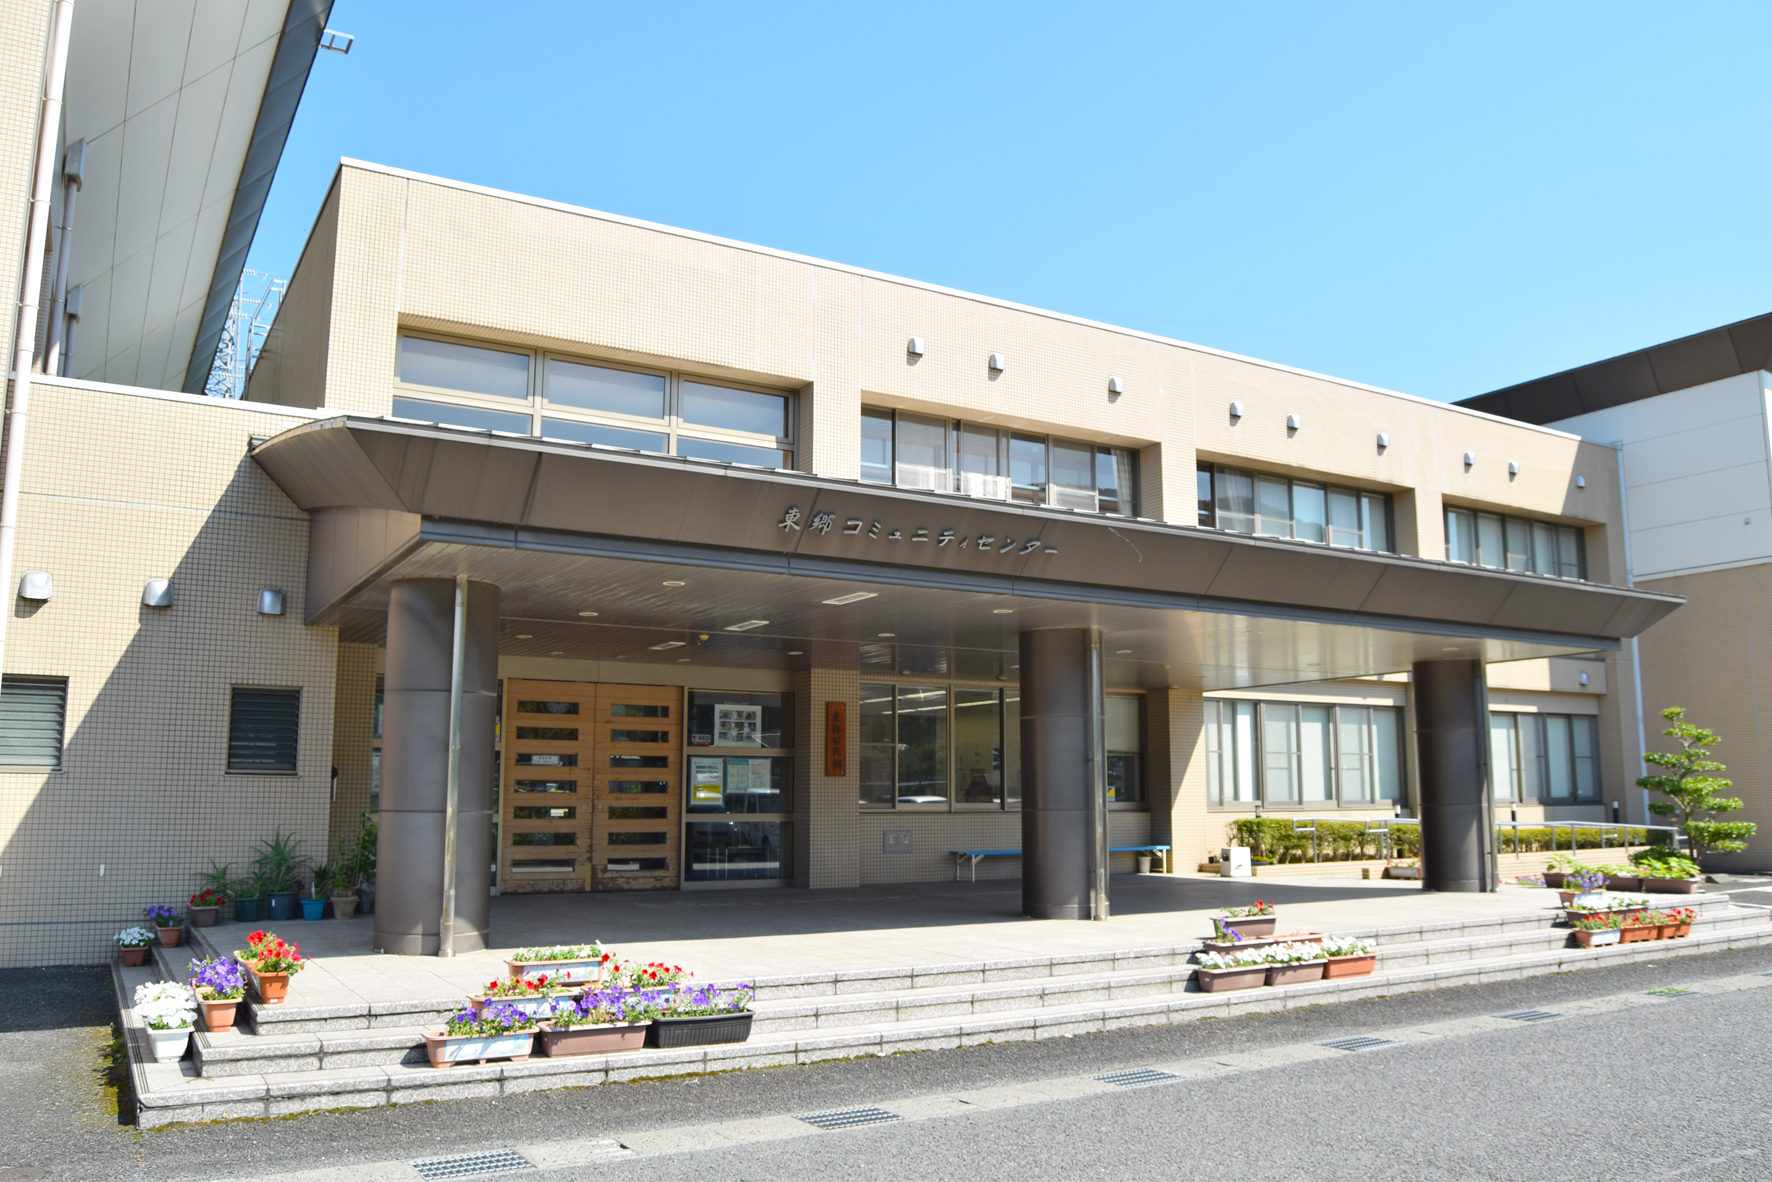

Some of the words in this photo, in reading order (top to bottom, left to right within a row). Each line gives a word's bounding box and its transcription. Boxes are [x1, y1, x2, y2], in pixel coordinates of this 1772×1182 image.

[777, 505, 1059, 555] 東郷コミュニティセンター
[831, 709, 843, 771] 東郷公民館
